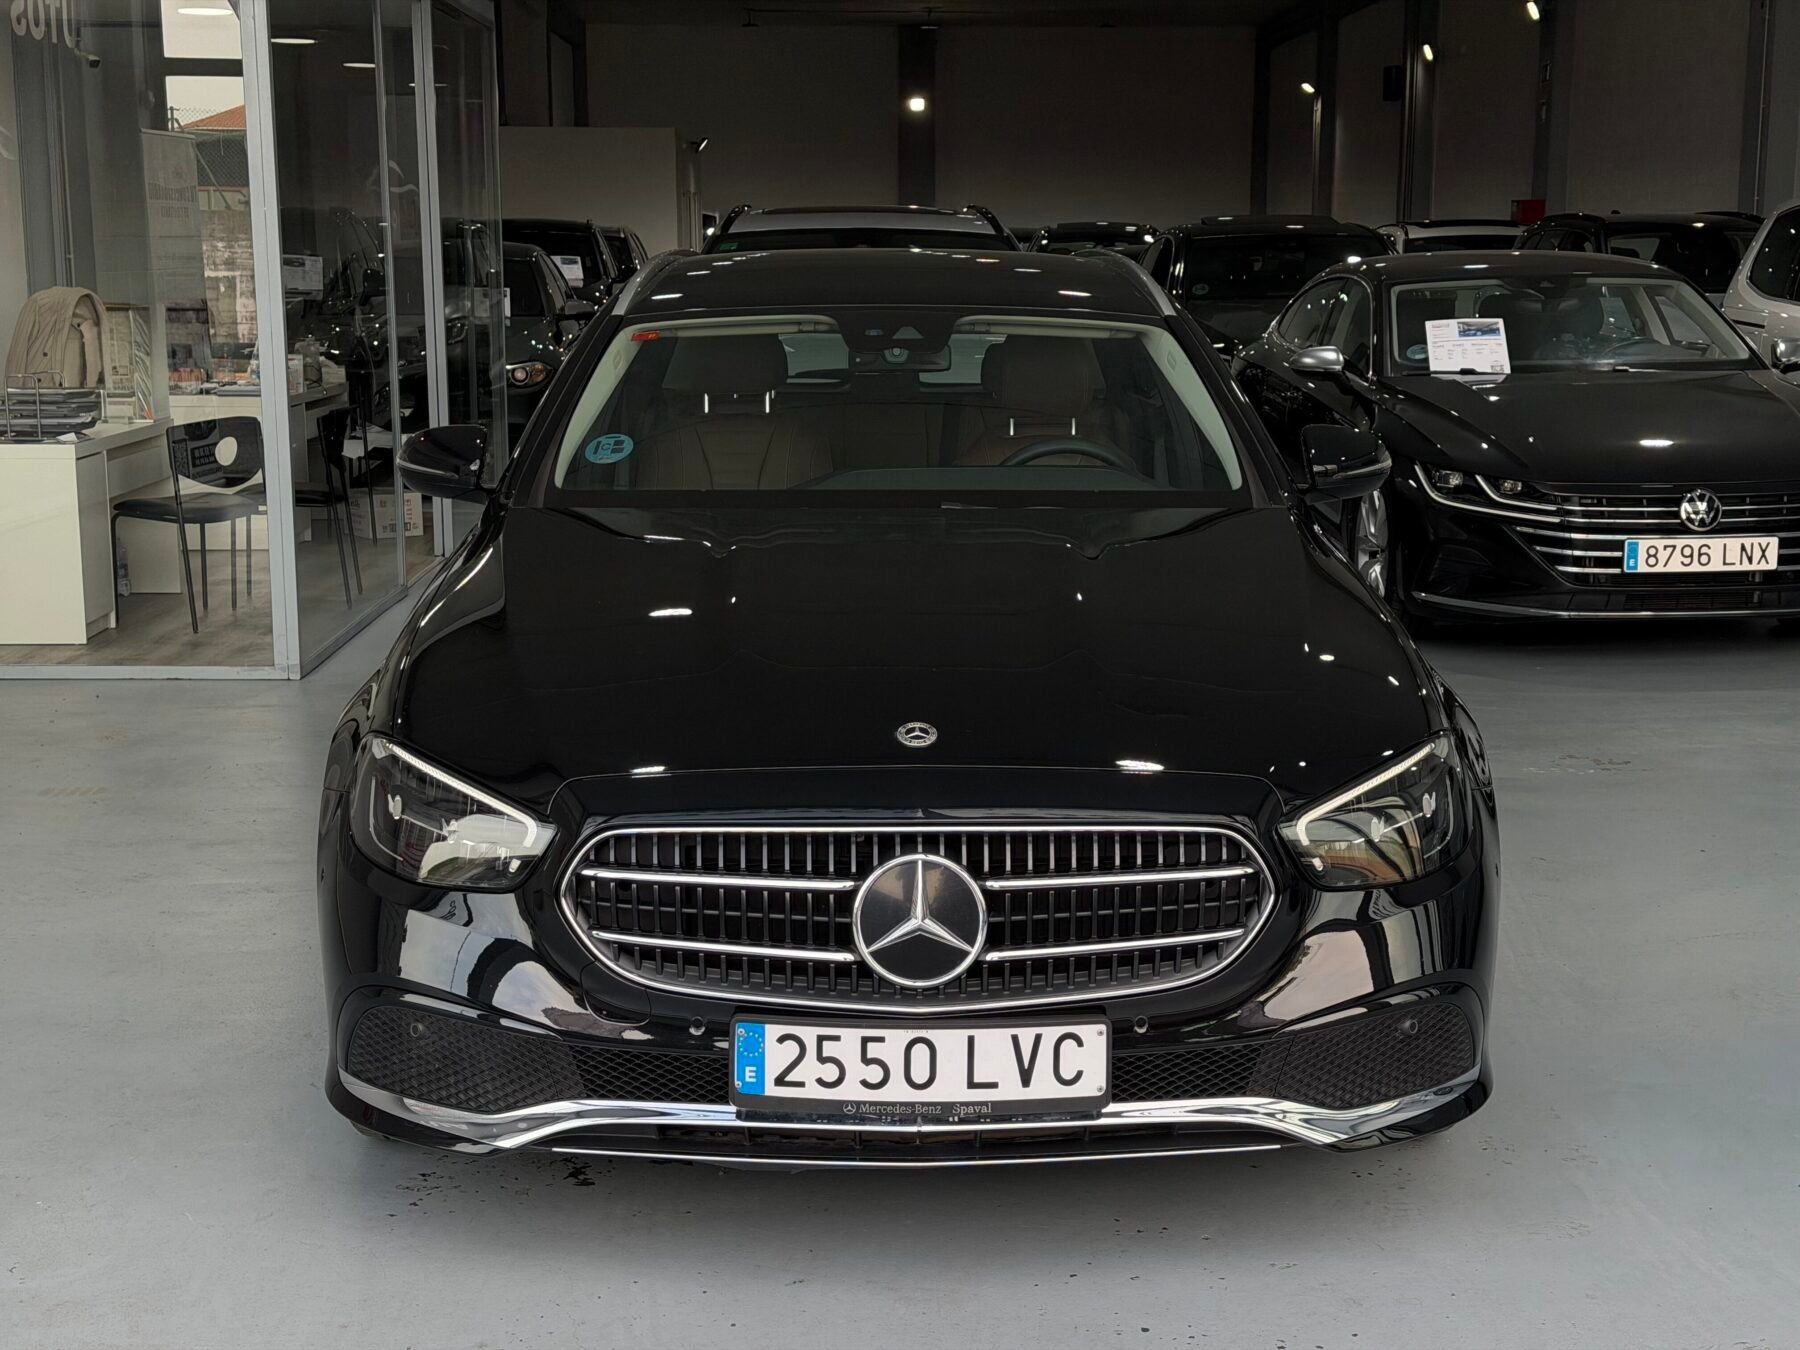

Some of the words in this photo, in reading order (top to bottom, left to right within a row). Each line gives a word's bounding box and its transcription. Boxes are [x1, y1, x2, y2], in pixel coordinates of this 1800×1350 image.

[1645, 543, 1712, 568] 8796
[1722, 541, 1771, 566] LNX
[773, 1032, 938, 1091] 2550
[966, 1031, 1085, 1090] LVC
[744, 1066, 757, 1082] E
[859, 1102, 942, 1114] Mercedes-Benz
[952, 1102, 992, 1116] Spaval
